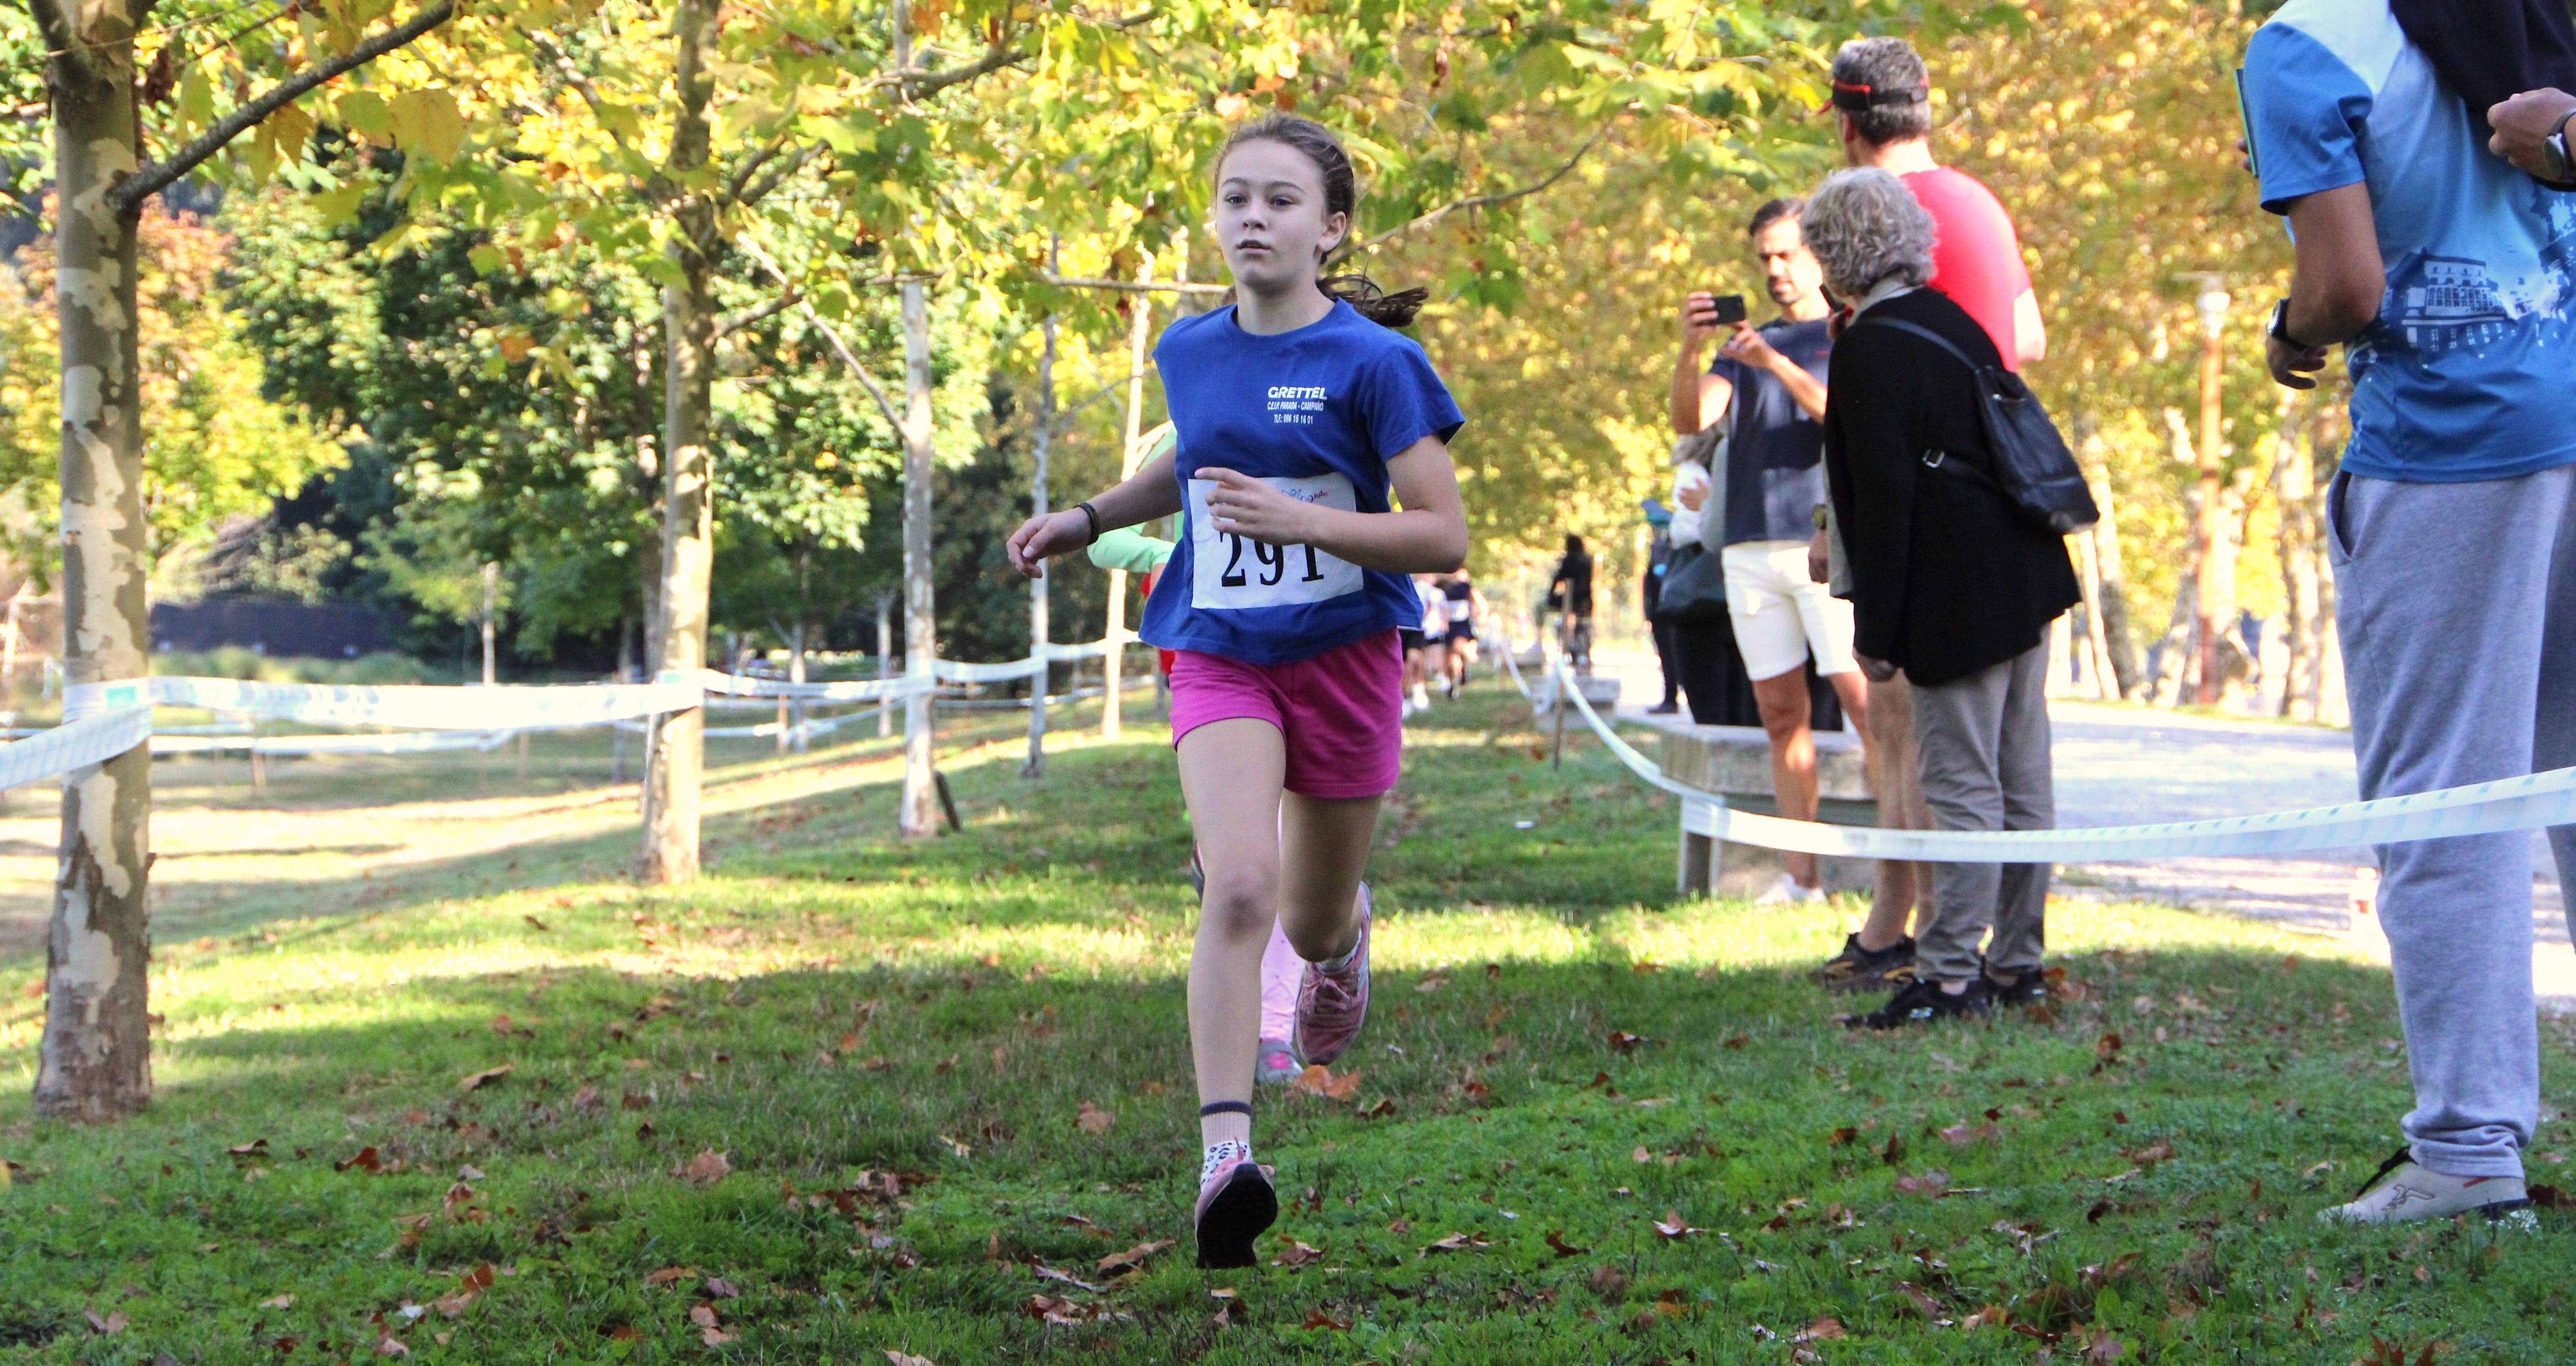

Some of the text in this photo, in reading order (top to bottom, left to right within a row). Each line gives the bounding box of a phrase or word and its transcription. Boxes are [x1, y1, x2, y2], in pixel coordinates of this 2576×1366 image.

[1268, 386, 1327, 400] GRETTEL
[1280, 401, 1297, 410] PARADA
[1301, 401, 1324, 411] CAMPAÑO
[1293, 414, 1299, 423] 15
[1300, 415, 1307, 424] 16
[1307, 415, 1313, 424] 01
[1219, 531, 1324, 587] 291
